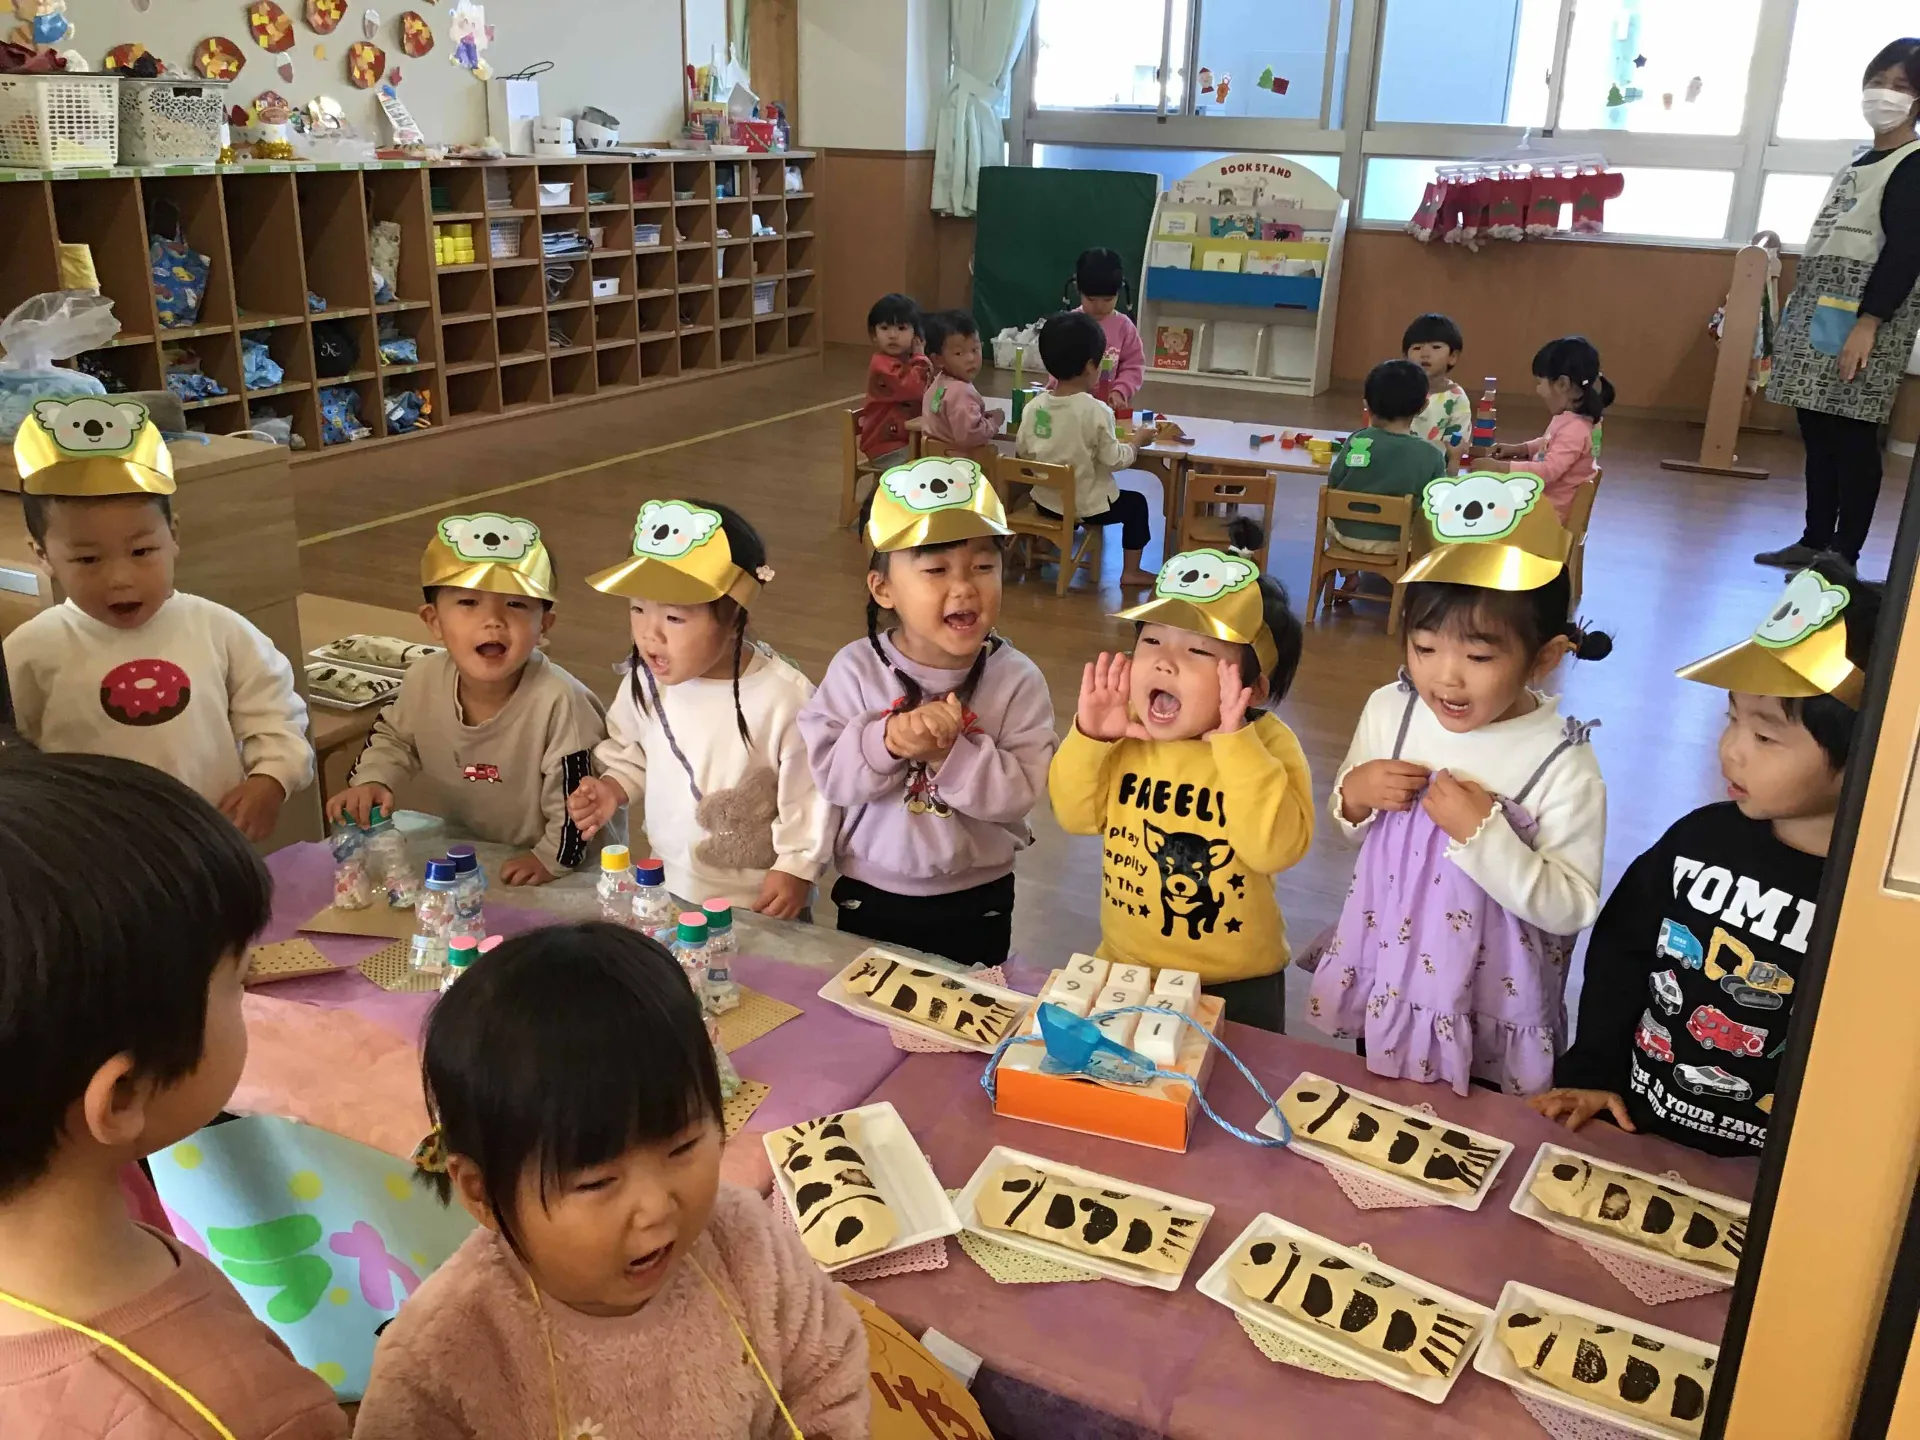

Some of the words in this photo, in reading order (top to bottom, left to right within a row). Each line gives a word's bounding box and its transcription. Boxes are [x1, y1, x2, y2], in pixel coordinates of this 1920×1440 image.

[1220, 162, 1253, 176] BOOK
[1255, 163, 1292, 179] STAND
[1109, 826, 1140, 848] play
[1103, 849, 1149, 877] appily
[1116, 876, 1145, 897] The
[1664, 1092, 1716, 1125] YOUR
[1670, 1112, 1747, 1143] TIMELESS
